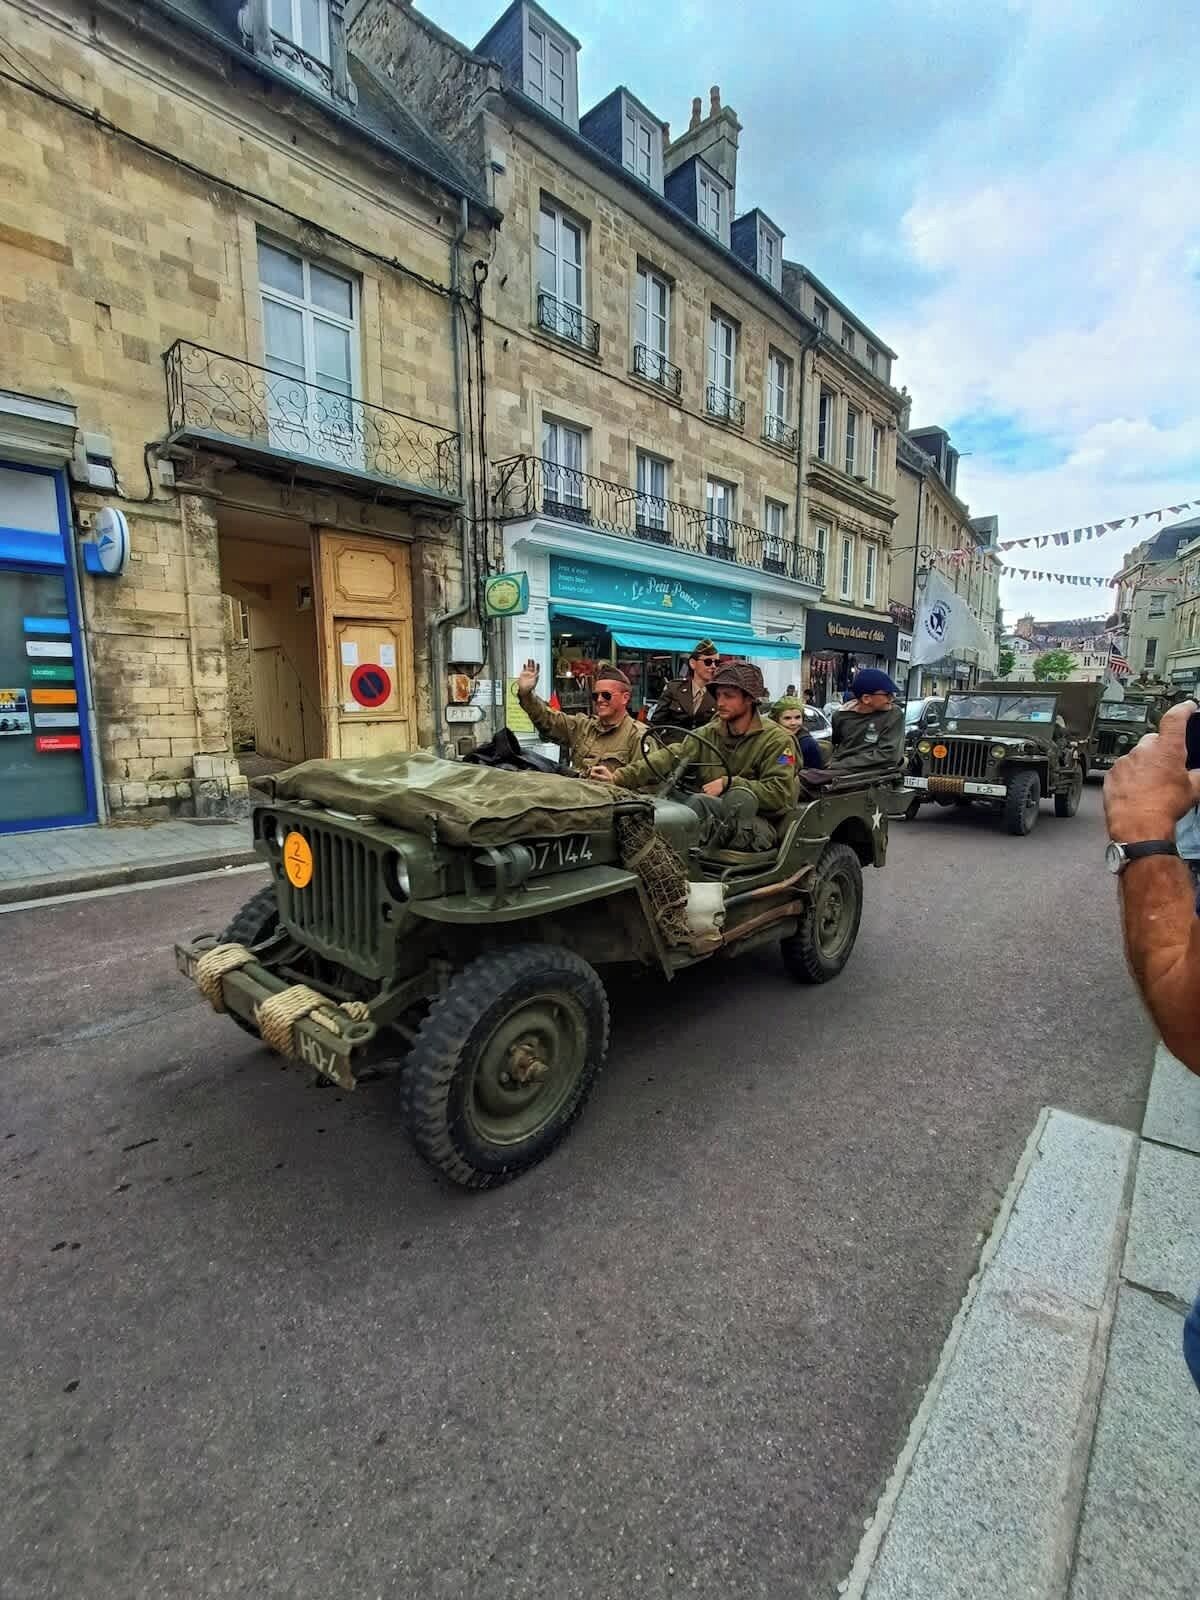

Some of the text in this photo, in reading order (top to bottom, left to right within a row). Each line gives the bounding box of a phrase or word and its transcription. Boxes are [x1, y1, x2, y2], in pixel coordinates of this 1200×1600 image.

[632, 581, 644, 600] Le
[646, 576, 670, 593] Petit
[294, 841, 301, 857] 2
[295, 863, 302, 879] 2
